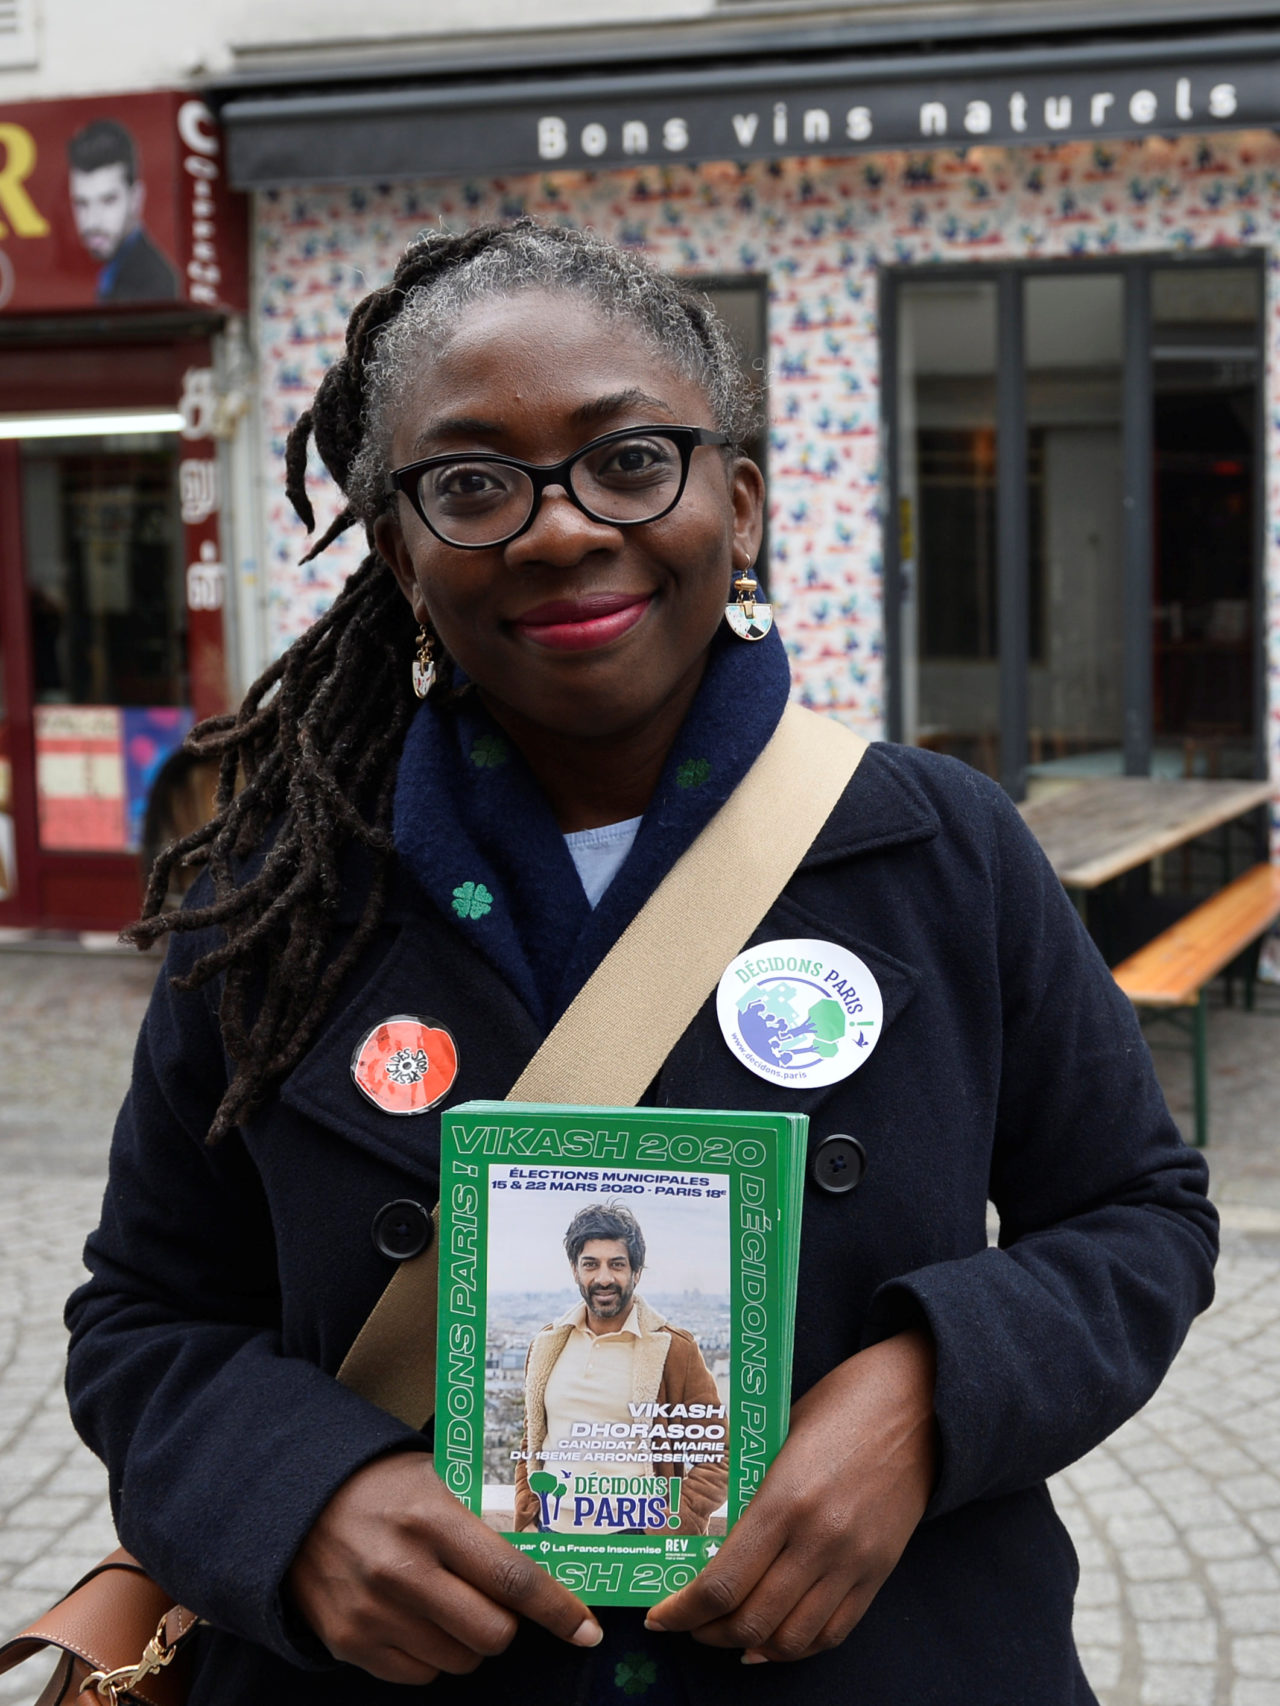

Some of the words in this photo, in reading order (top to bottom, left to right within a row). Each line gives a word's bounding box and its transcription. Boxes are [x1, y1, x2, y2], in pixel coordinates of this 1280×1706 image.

[538, 116, 689, 159] Bons
[732, 102, 873, 146] vins
[920, 77, 1238, 136] naturels
[735, 956, 823, 984] DÉCIDONS
[823, 969, 863, 1015] PARIS
[731, 1032, 808, 1080] www.decidons.paris
[451, 1125, 630, 1160] VIKASH
[635, 1133, 767, 1168] 2020
[491, 1180, 508, 1190] 15
[510, 1180, 522, 1190] &
[525, 1181, 547, 1191] 22
[549, 1182, 598, 1193] MARS
[600, 1183, 645, 1194] 2020
[655, 1186, 702, 1198] PARIS
[509, 1167, 599, 1181] ÉLECTIONS
[602, 1172, 710, 1187] MUNICIPALES
[450, 1184, 479, 1317] PARIS
[740, 1172, 772, 1396] DÉCIDONS
[445, 1323, 476, 1511] CIDONS
[628, 1403, 726, 1419] VIKASH
[571, 1422, 725, 1440] DHORASOO
[509, 1450, 533, 1460] DU
[583, 1451, 725, 1463] ARRONDISSEMENT
[558, 1440, 636, 1451] CANDIDAT
[651, 1441, 671, 1451] LA
[673, 1441, 726, 1451] MAIRIE
[737, 1400, 767, 1520] PARI
[574, 1472, 668, 1496] DÉCIDONS
[552, 1543, 566, 1553] La
[567, 1544, 606, 1553] France
[607, 1545, 662, 1554] Insoumise
[665, 1538, 689, 1553] REV
